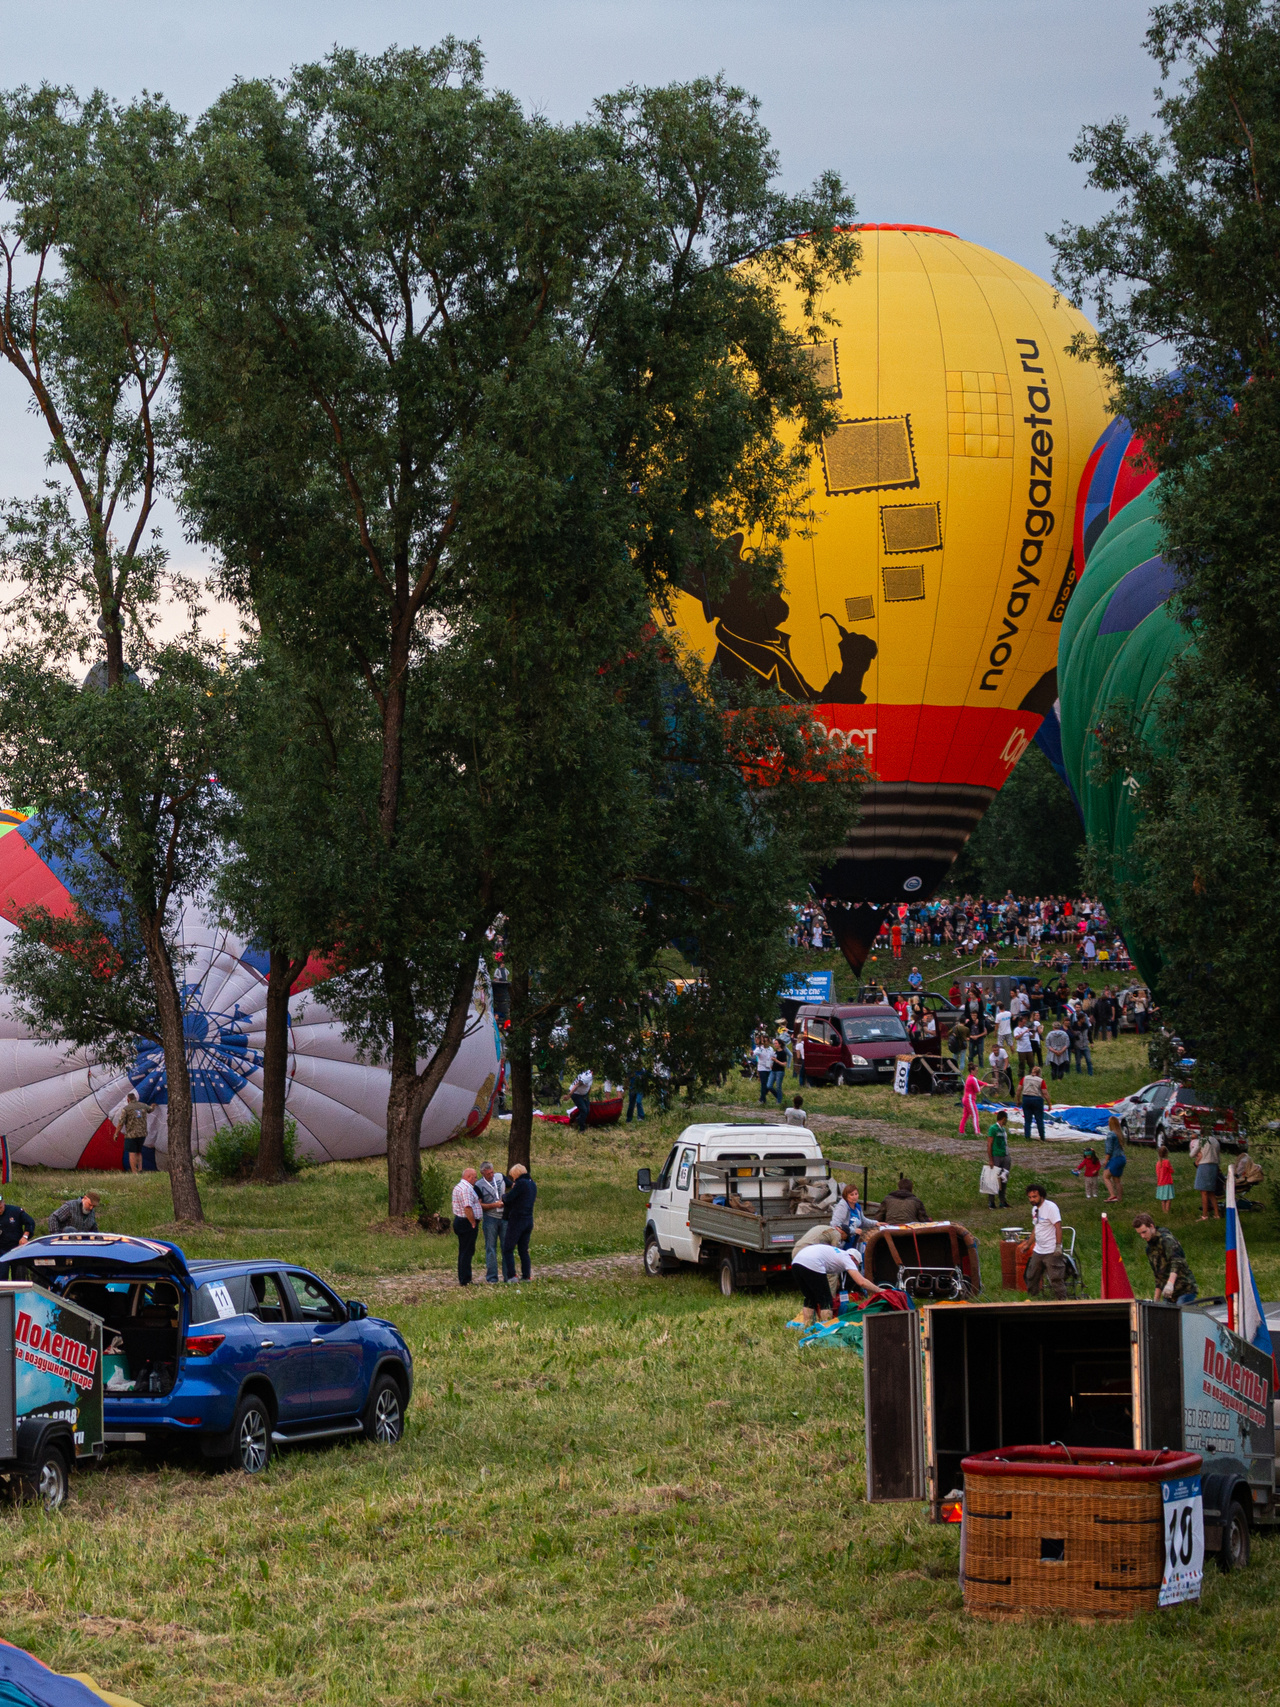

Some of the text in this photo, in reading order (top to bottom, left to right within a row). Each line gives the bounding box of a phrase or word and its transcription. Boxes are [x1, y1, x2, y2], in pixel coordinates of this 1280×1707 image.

[979, 338, 1055, 691] novayagazeta.ru
[214, 1288, 229, 1307] 11
[15, 1310, 98, 1375] Полеты
[24, 1351, 71, 1380] воздушном
[71, 1371, 94, 1391] шаре
[1202, 1336, 1269, 1409] Полеты
[1169, 1505, 1194, 1569] 10
